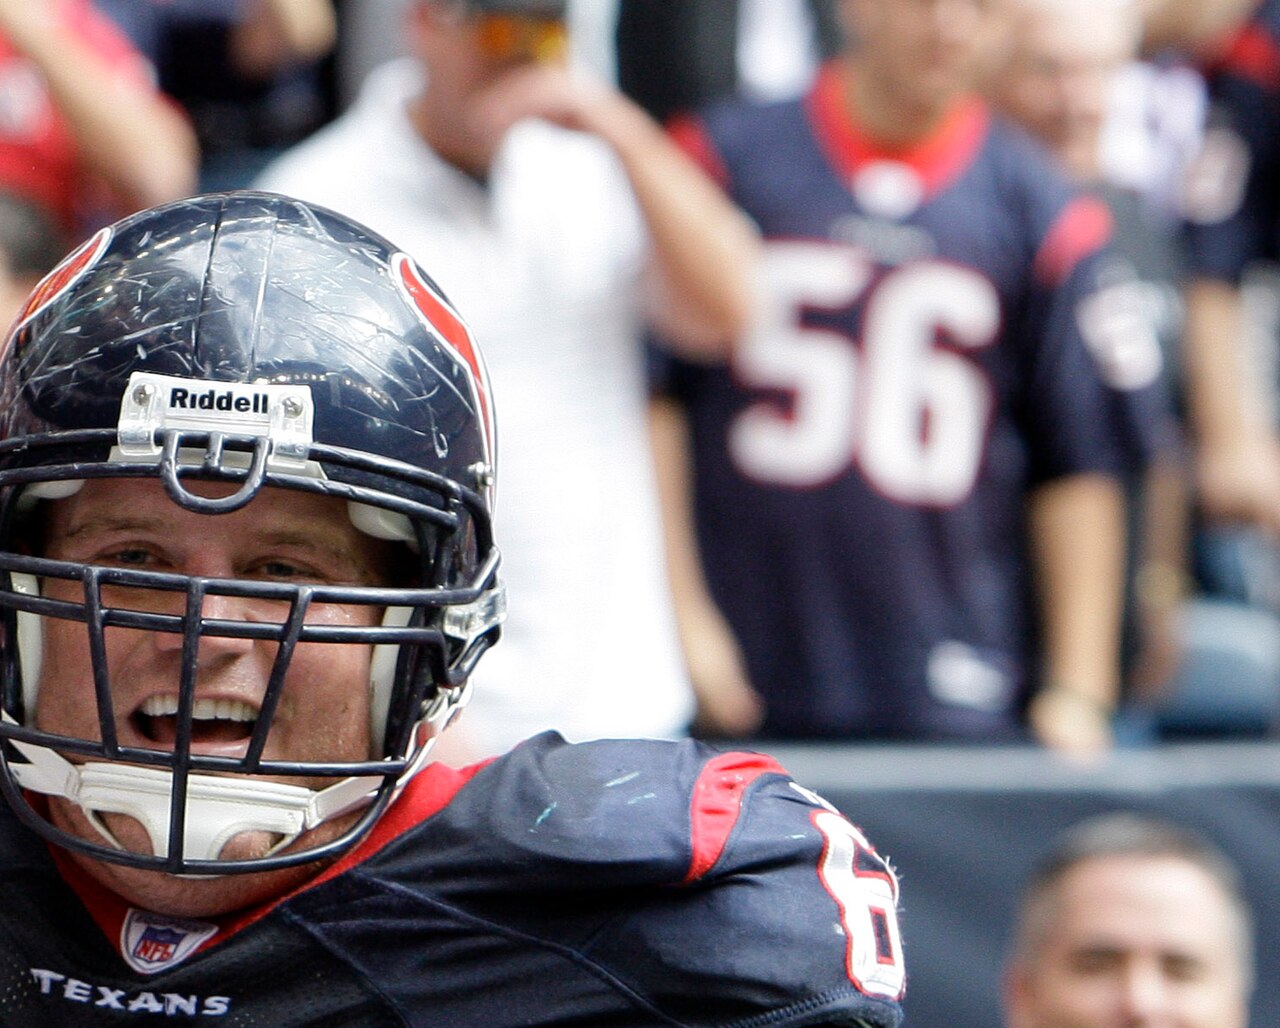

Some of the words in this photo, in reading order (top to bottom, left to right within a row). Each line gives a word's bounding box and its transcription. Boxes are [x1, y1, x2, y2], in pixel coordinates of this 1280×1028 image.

[727, 238, 1003, 508] 56
[170, 388, 268, 413] Riddell
[29, 967, 233, 1017] TEXANS
